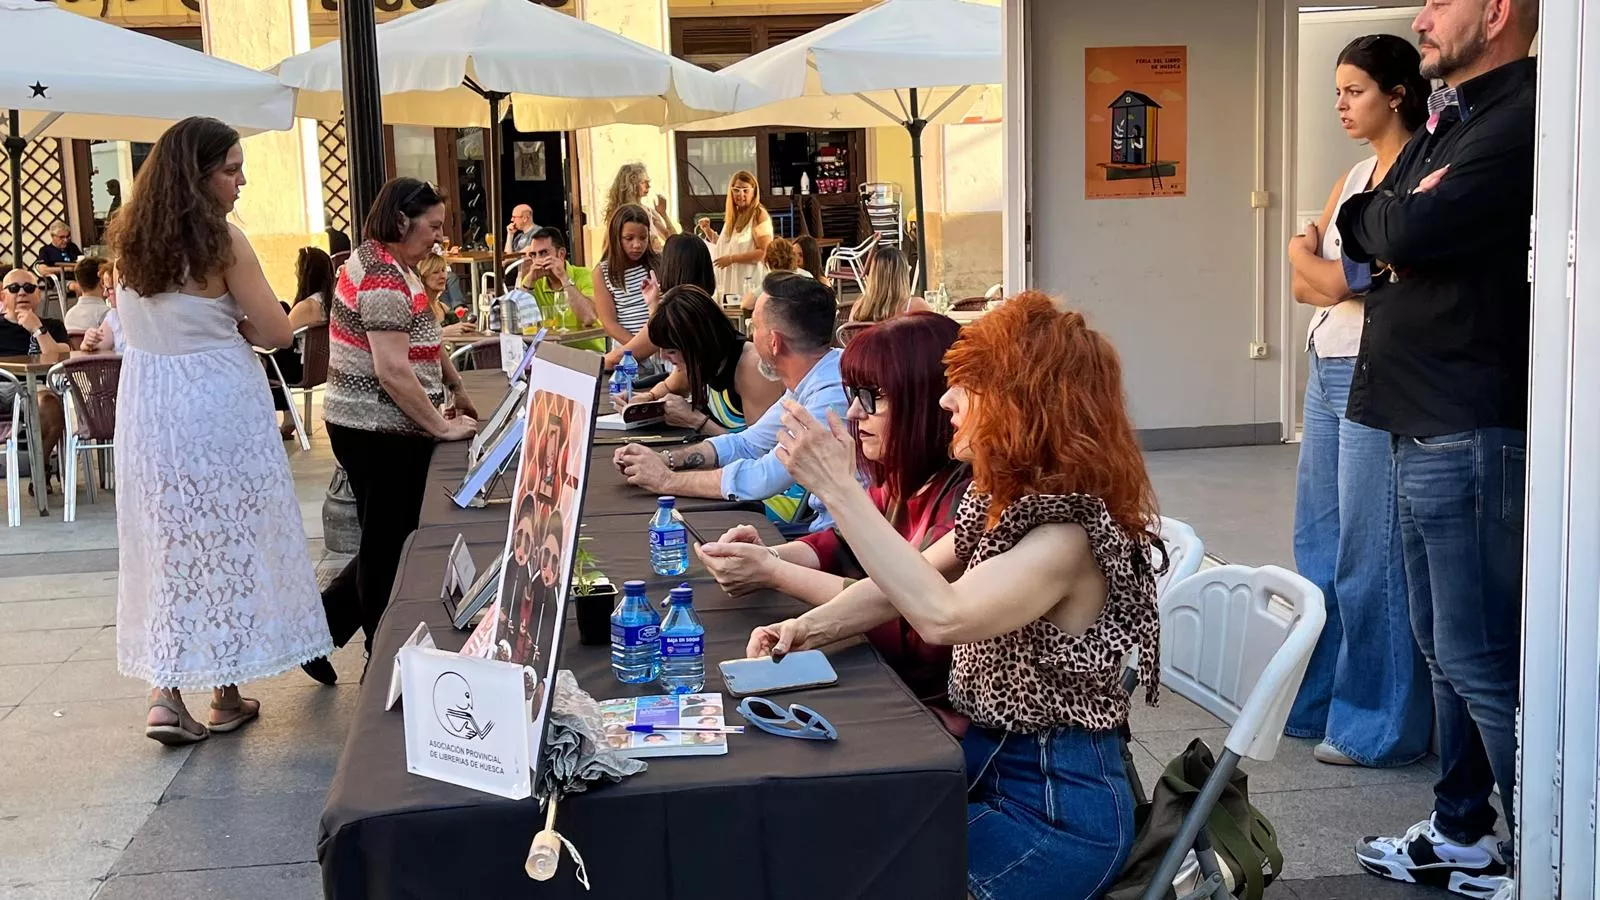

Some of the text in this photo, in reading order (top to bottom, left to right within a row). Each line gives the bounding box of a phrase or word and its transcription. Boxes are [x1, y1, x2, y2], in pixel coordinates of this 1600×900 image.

[430, 750, 438, 758] DE
[470, 760, 479, 768] DE
[479, 763, 505, 775] HUESCA
[465, 748, 501, 763] PROVINCIAL
